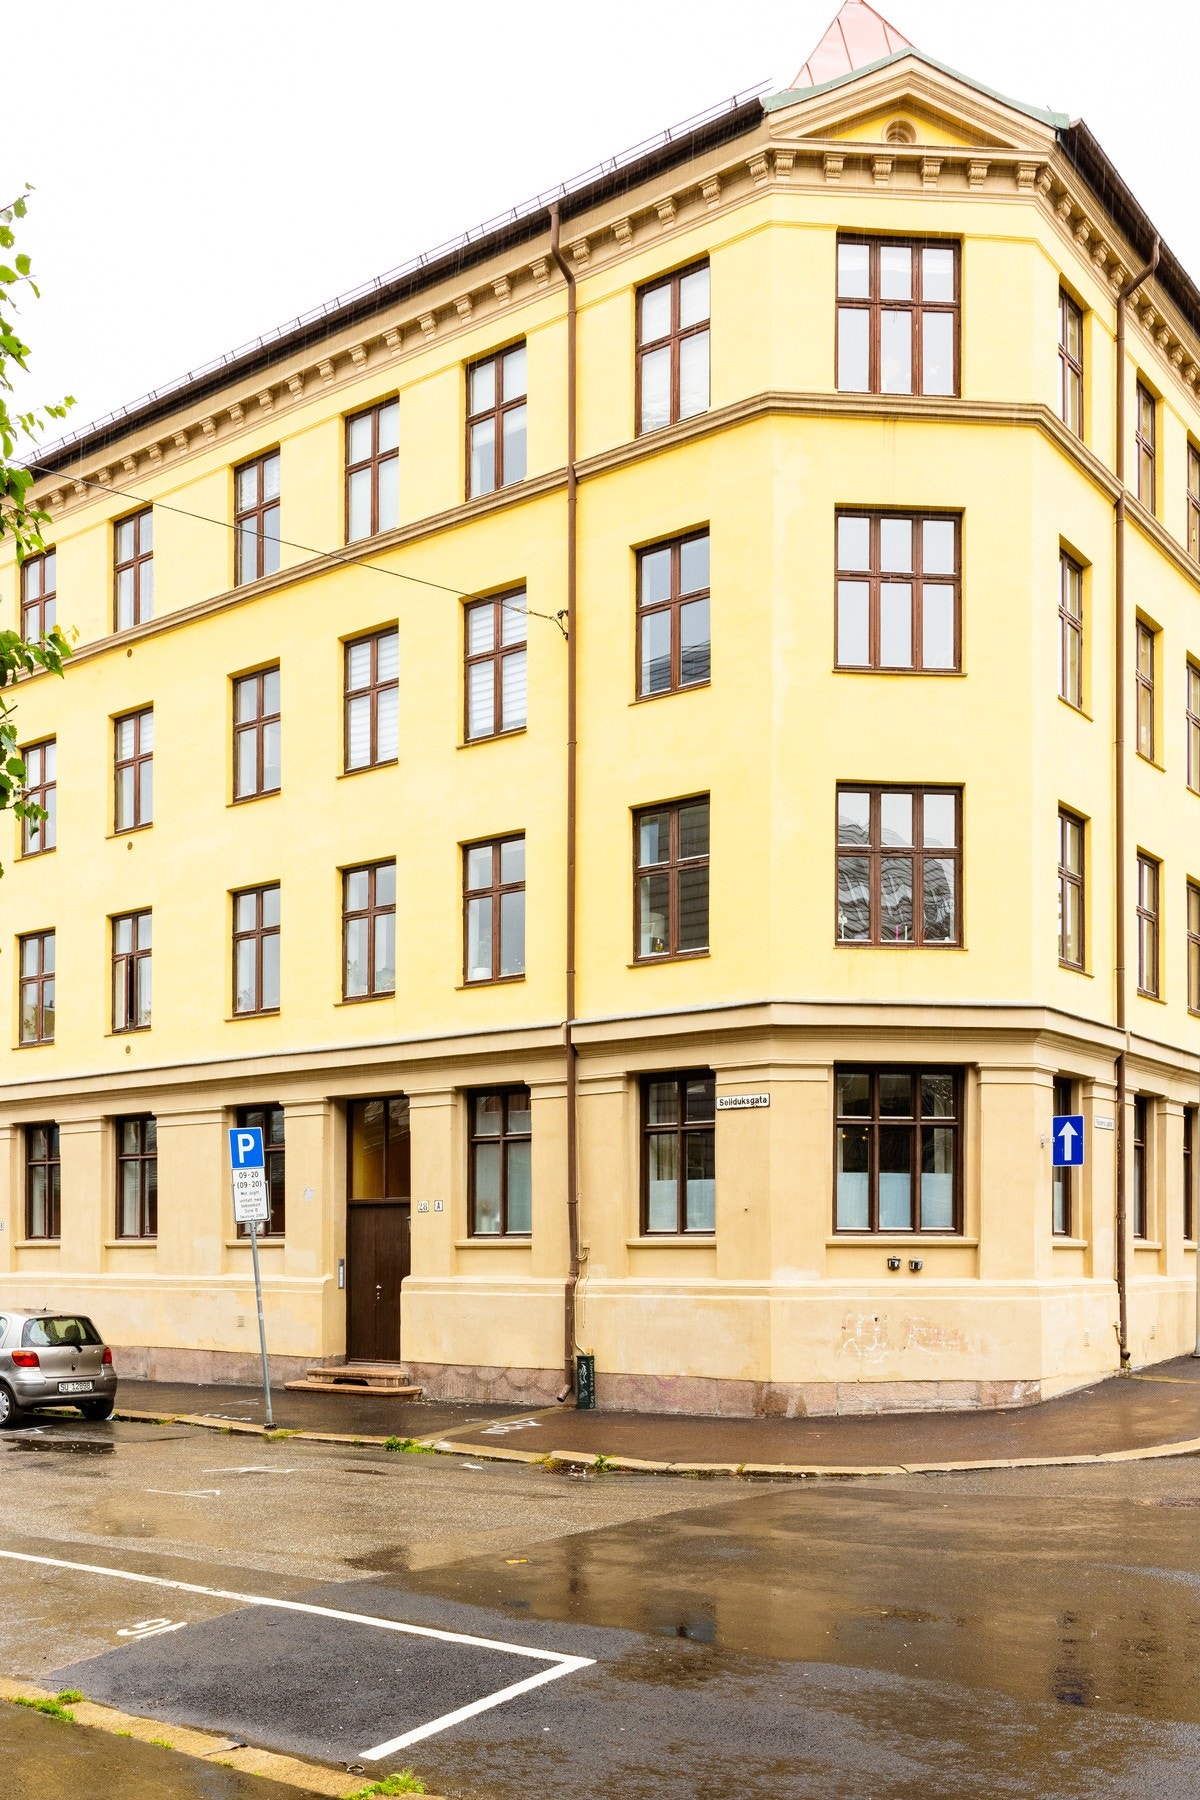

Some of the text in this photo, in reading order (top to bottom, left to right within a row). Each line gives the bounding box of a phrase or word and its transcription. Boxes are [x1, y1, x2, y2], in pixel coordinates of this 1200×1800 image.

[719, 1096, 767, 1107] Seilduksgata
[237, 1133, 255, 1164] P
[60, 1383, 69, 1391] SU
